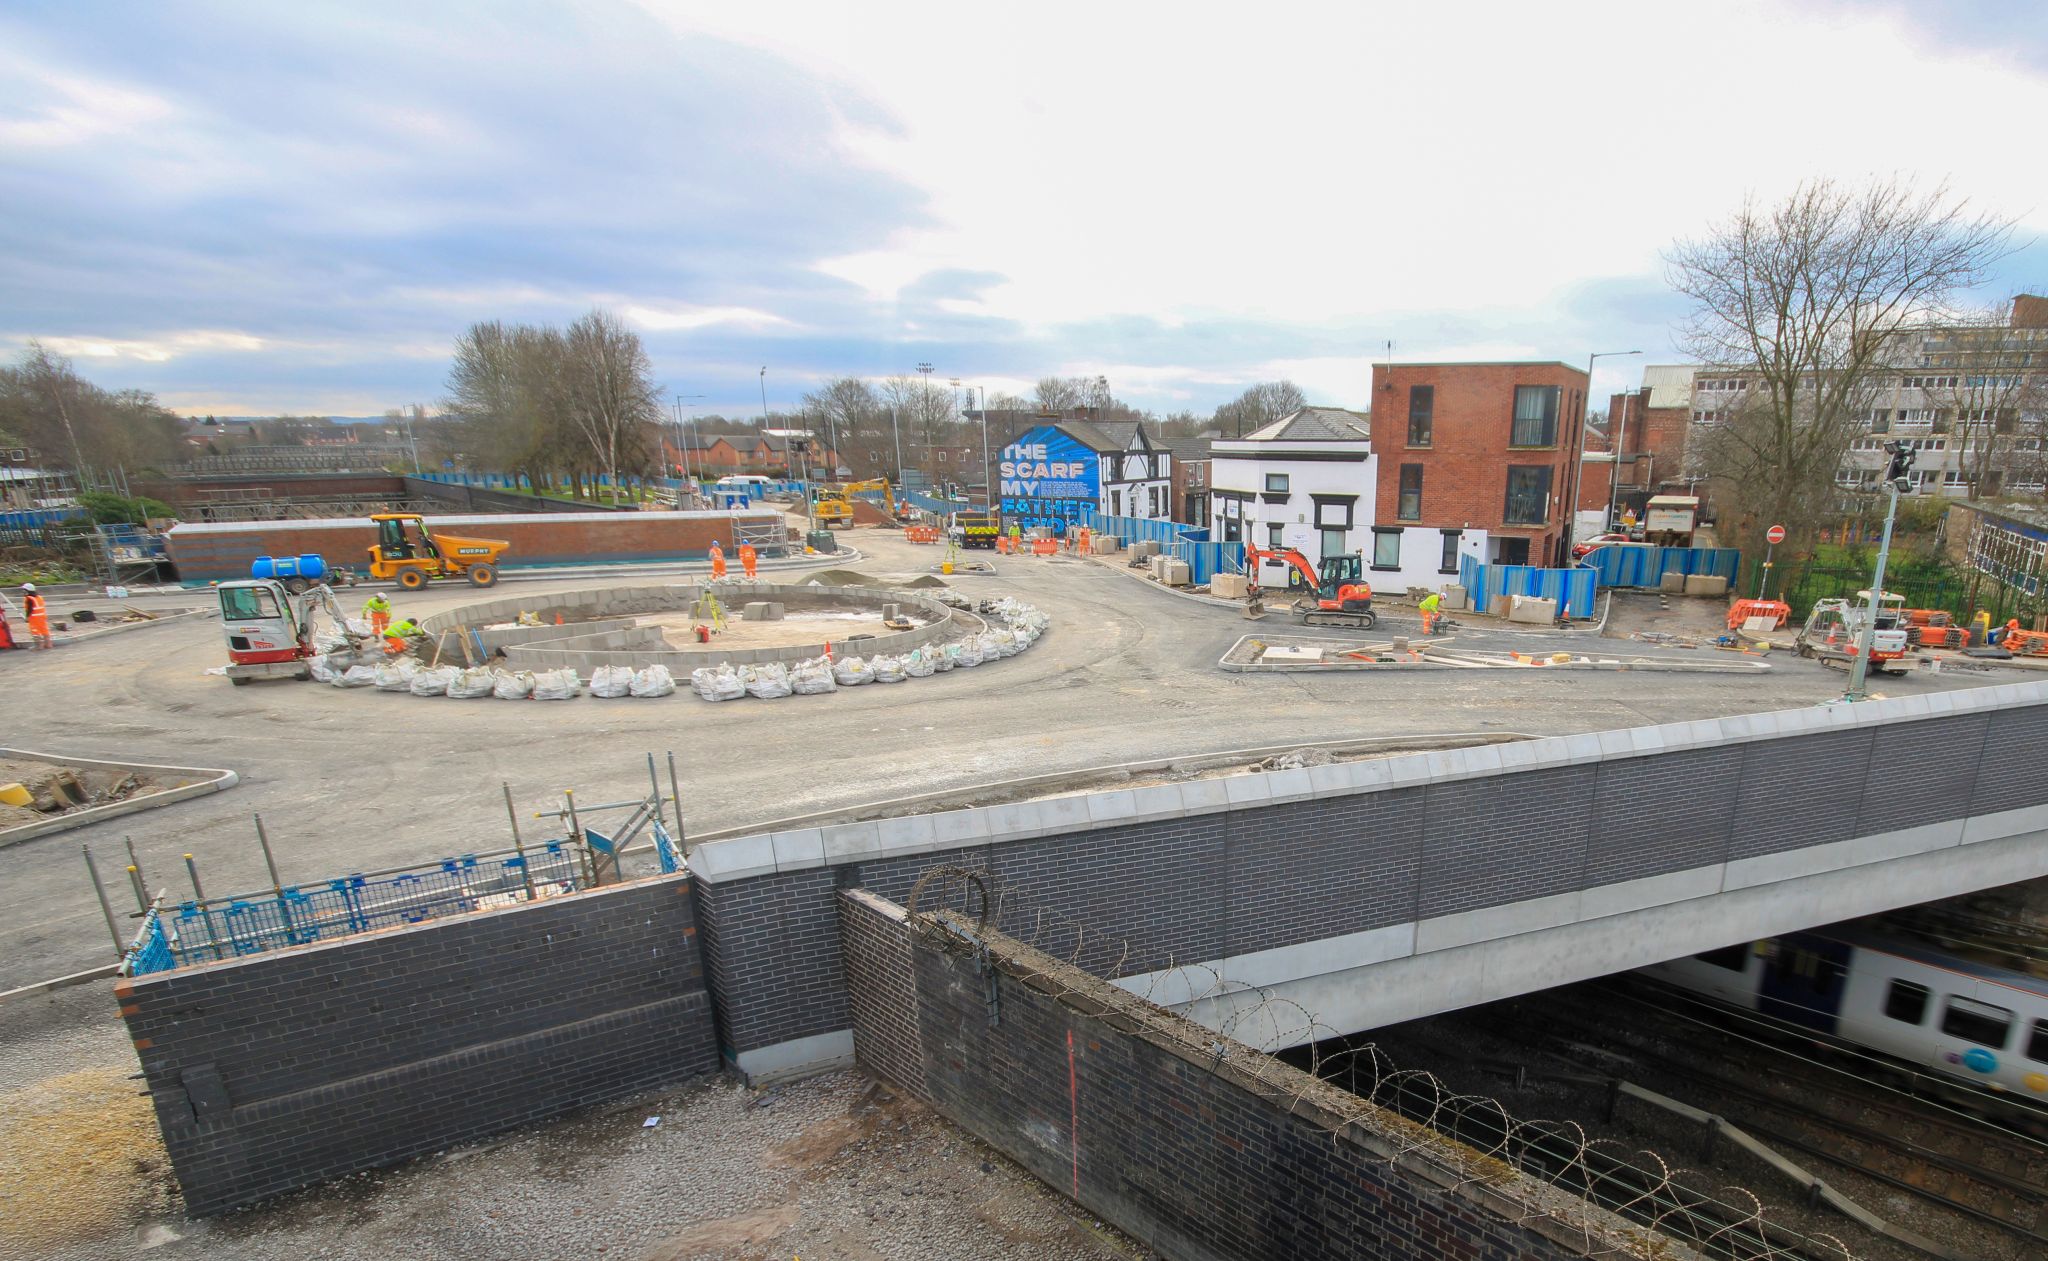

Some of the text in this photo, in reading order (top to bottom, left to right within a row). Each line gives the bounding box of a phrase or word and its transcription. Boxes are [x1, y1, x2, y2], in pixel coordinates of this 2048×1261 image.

[1004, 443, 1048, 460] THE
[1000, 462, 1085, 479] SCARF
[1000, 480, 1039, 496] MY
